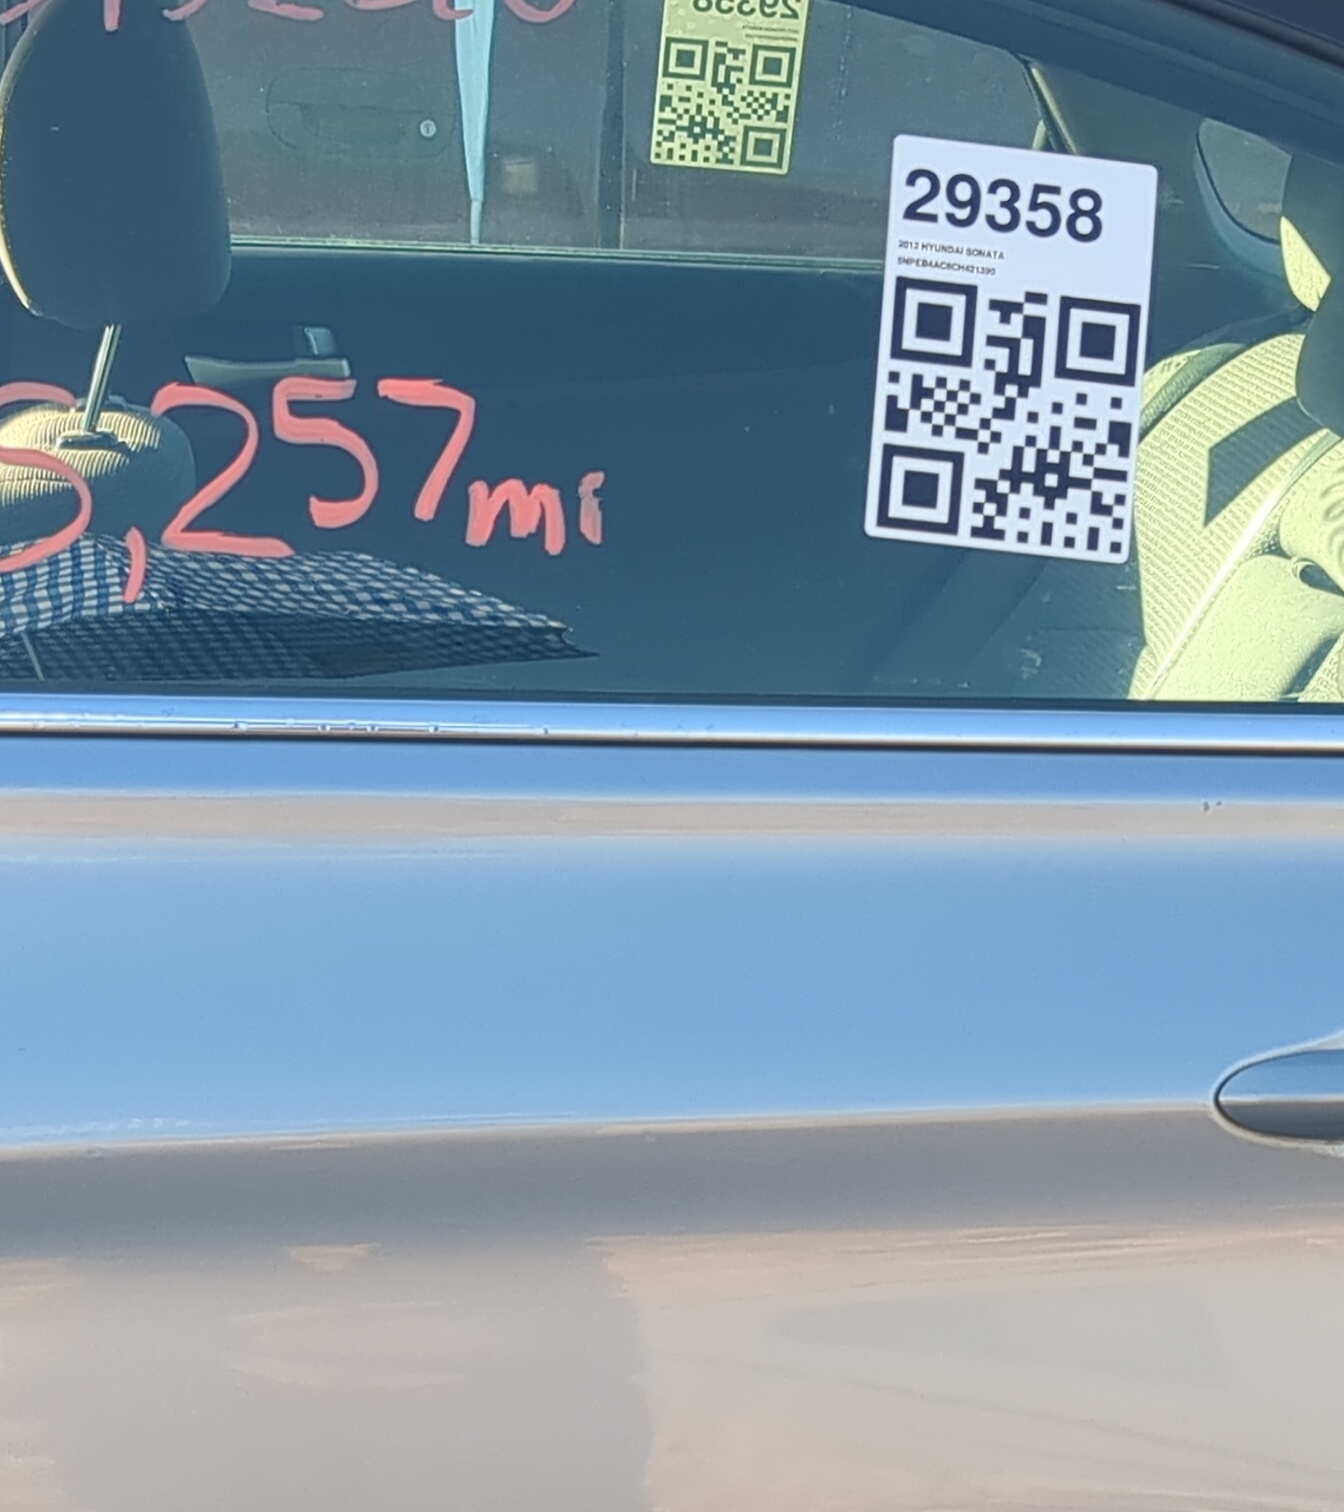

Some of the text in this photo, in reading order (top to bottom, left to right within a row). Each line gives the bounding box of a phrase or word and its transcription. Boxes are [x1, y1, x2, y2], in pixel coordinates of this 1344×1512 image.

[902, 168, 1104, 243] 29358
[898, 239, 1006, 260] 2012 HYUNDAI SONATA
